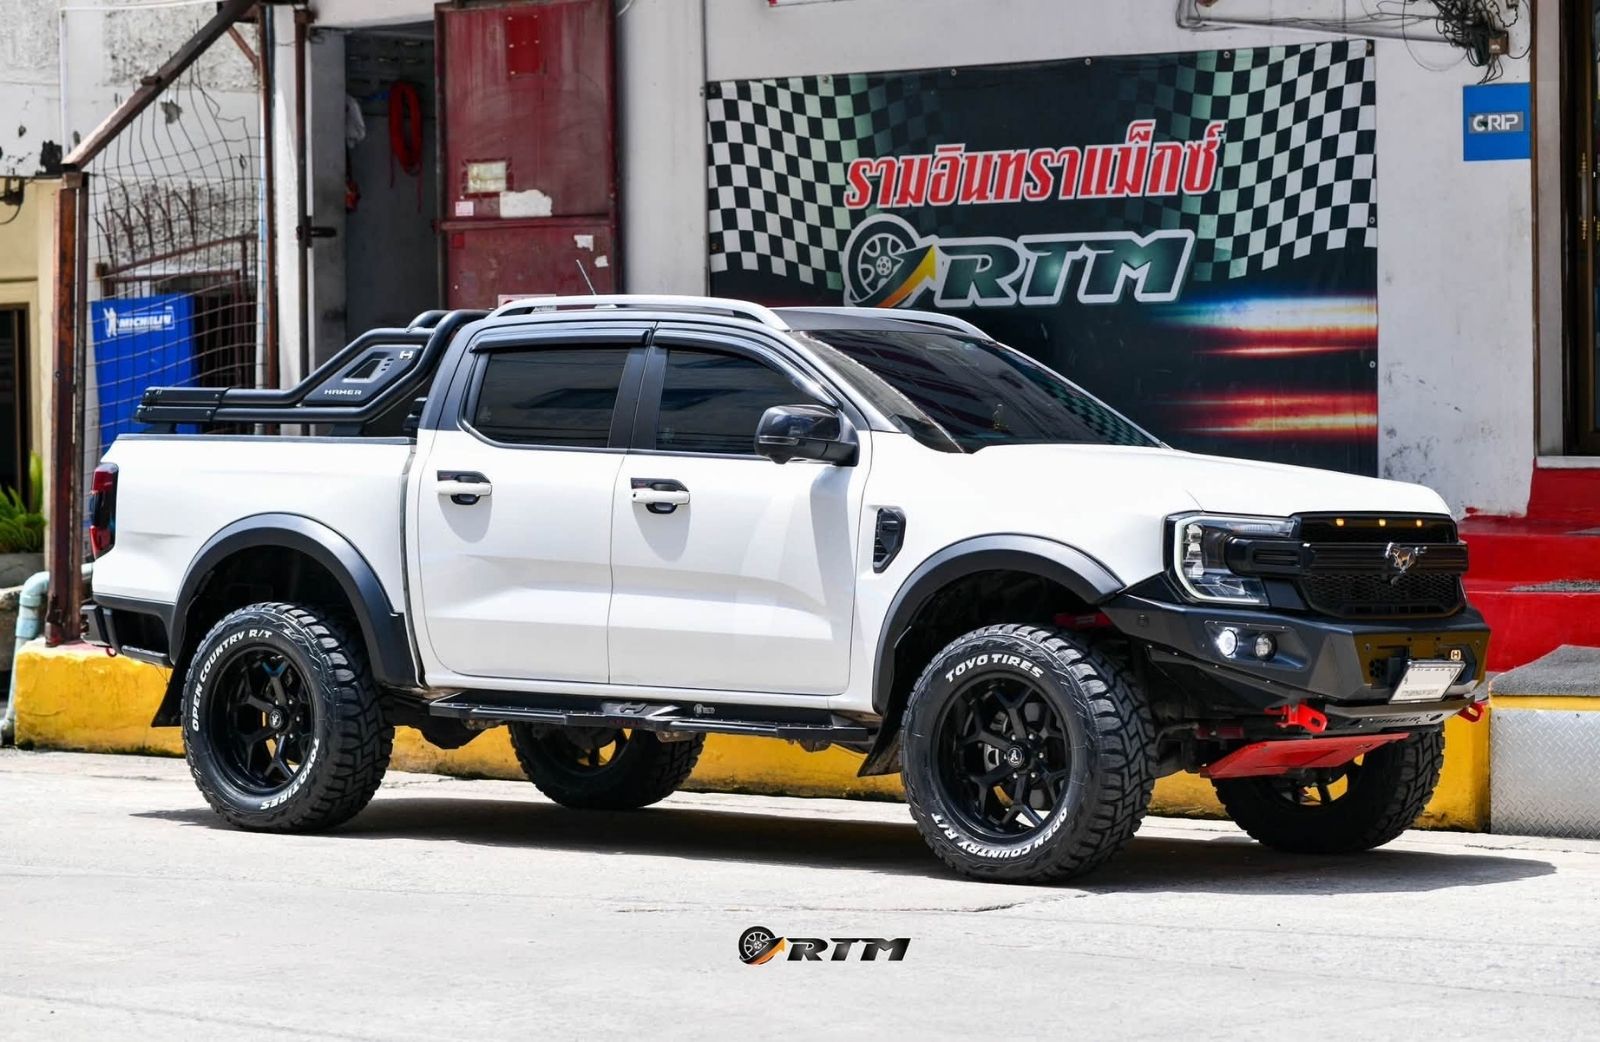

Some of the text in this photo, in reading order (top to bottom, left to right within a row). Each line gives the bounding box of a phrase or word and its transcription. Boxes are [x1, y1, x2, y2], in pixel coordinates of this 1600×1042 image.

[844, 119, 1226, 210] รามอินทราแม็กซ์
[934, 229, 1196, 307] RTM
[119, 314, 172, 329] MICHELIN
[324, 388, 362, 396] HAMER
[192, 628, 273, 732] OPEN COUNTRY R/T
[945, 653, 1044, 683] TOYO TIRES
[260, 738, 320, 810] TOYO TIRES
[931, 807, 1068, 858] OPEN COUNTRY R/T
